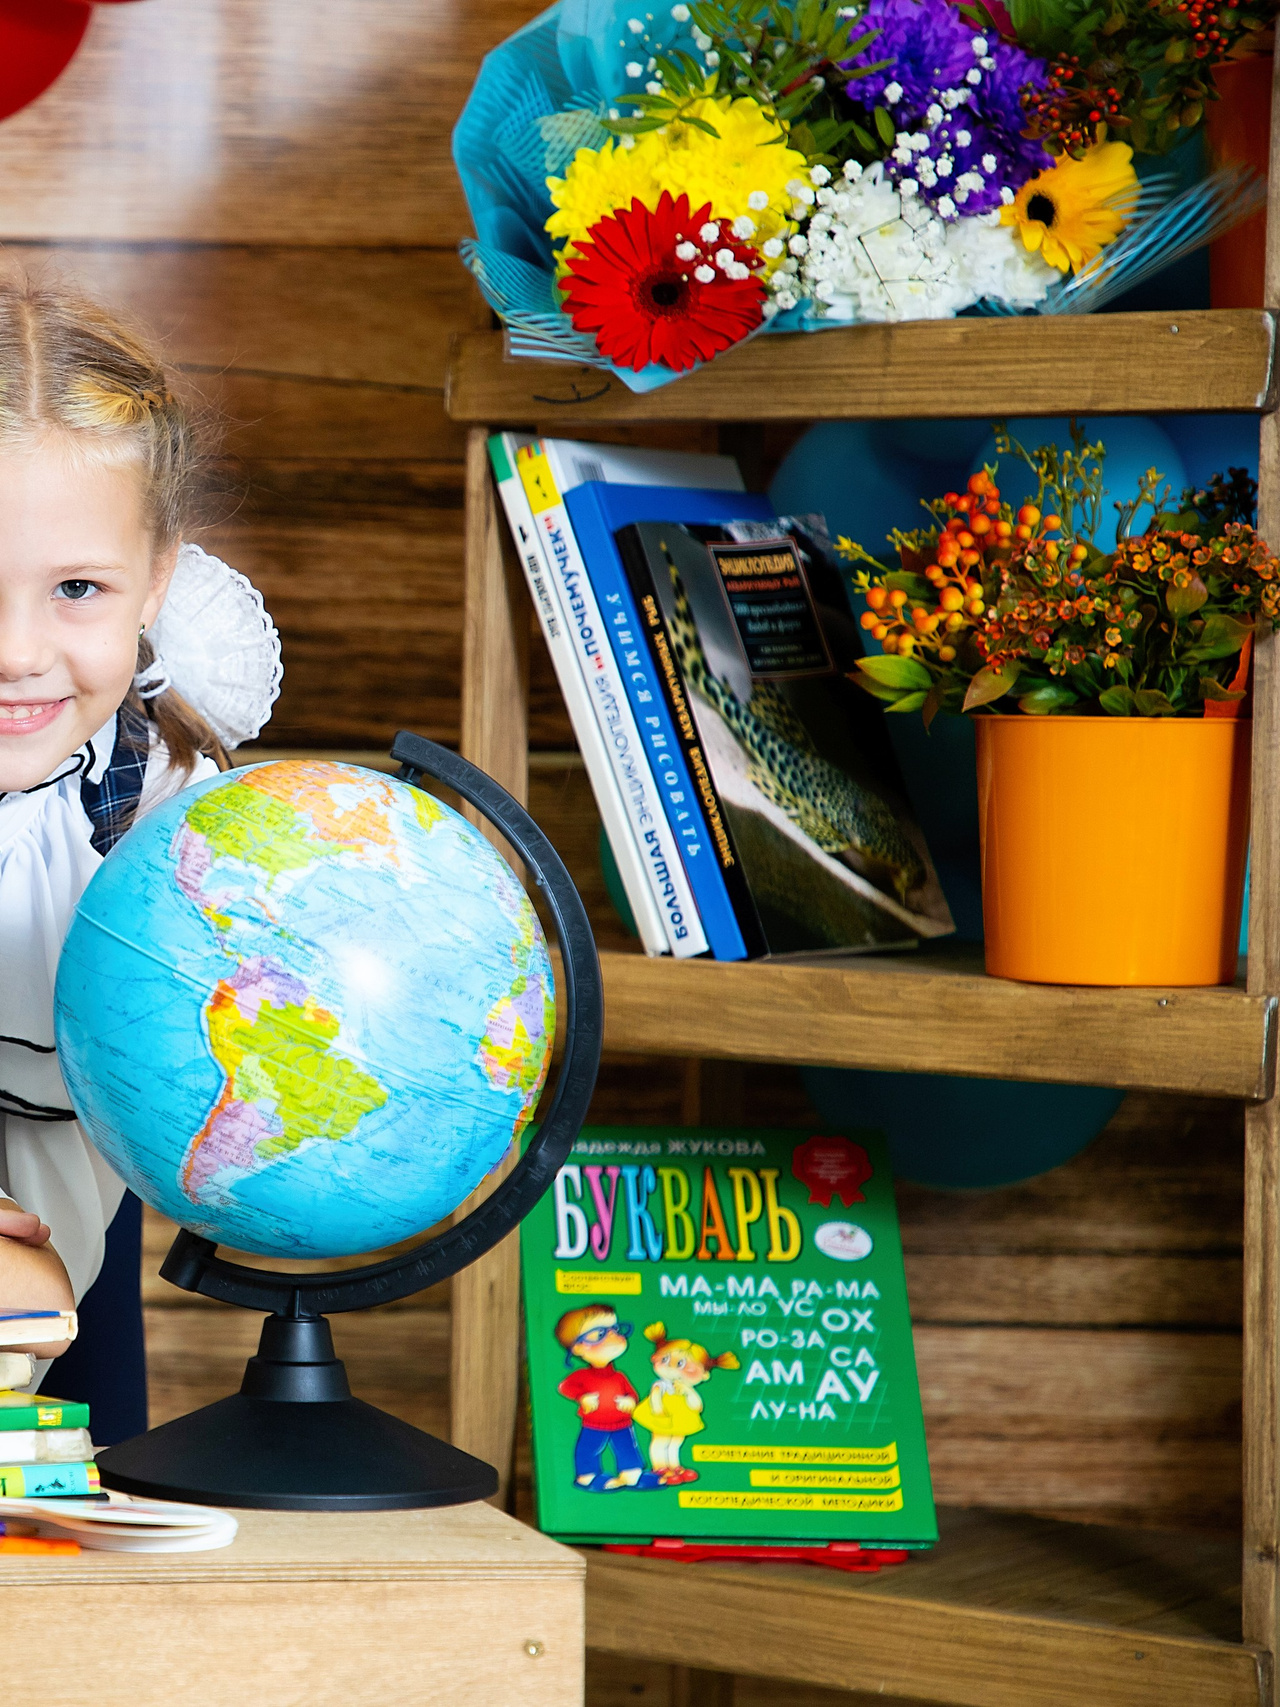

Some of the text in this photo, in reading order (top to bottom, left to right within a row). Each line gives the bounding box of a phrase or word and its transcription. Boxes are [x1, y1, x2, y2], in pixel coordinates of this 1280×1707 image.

[605, 591, 704, 858] УЧИМСЯ РИСОВАТЬ
[640, 595, 736, 868] ЭНЦИКЛОПЕДИЯ АКВАРИУМНЫХ РЫБ
[593, 673, 655, 827] ЭНЦИКЛОПЕДИЯ
[643, 828, 690, 940] БОЛЬШАЯ
[572, 1139, 766, 1156] адежда ЖУКОВА
[554, 1164, 802, 1262] БУКВАРЬ
[660, 1275, 881, 1299] МА-МА РА-МА
[693, 1297, 874, 1333] МЫ-ЛО УС ОХ
[741, 1328, 876, 1368] РО-ЗА СА
[745, 1359, 880, 1402] АМ АУ
[750, 1400, 837, 1420] ЛУ-НА
